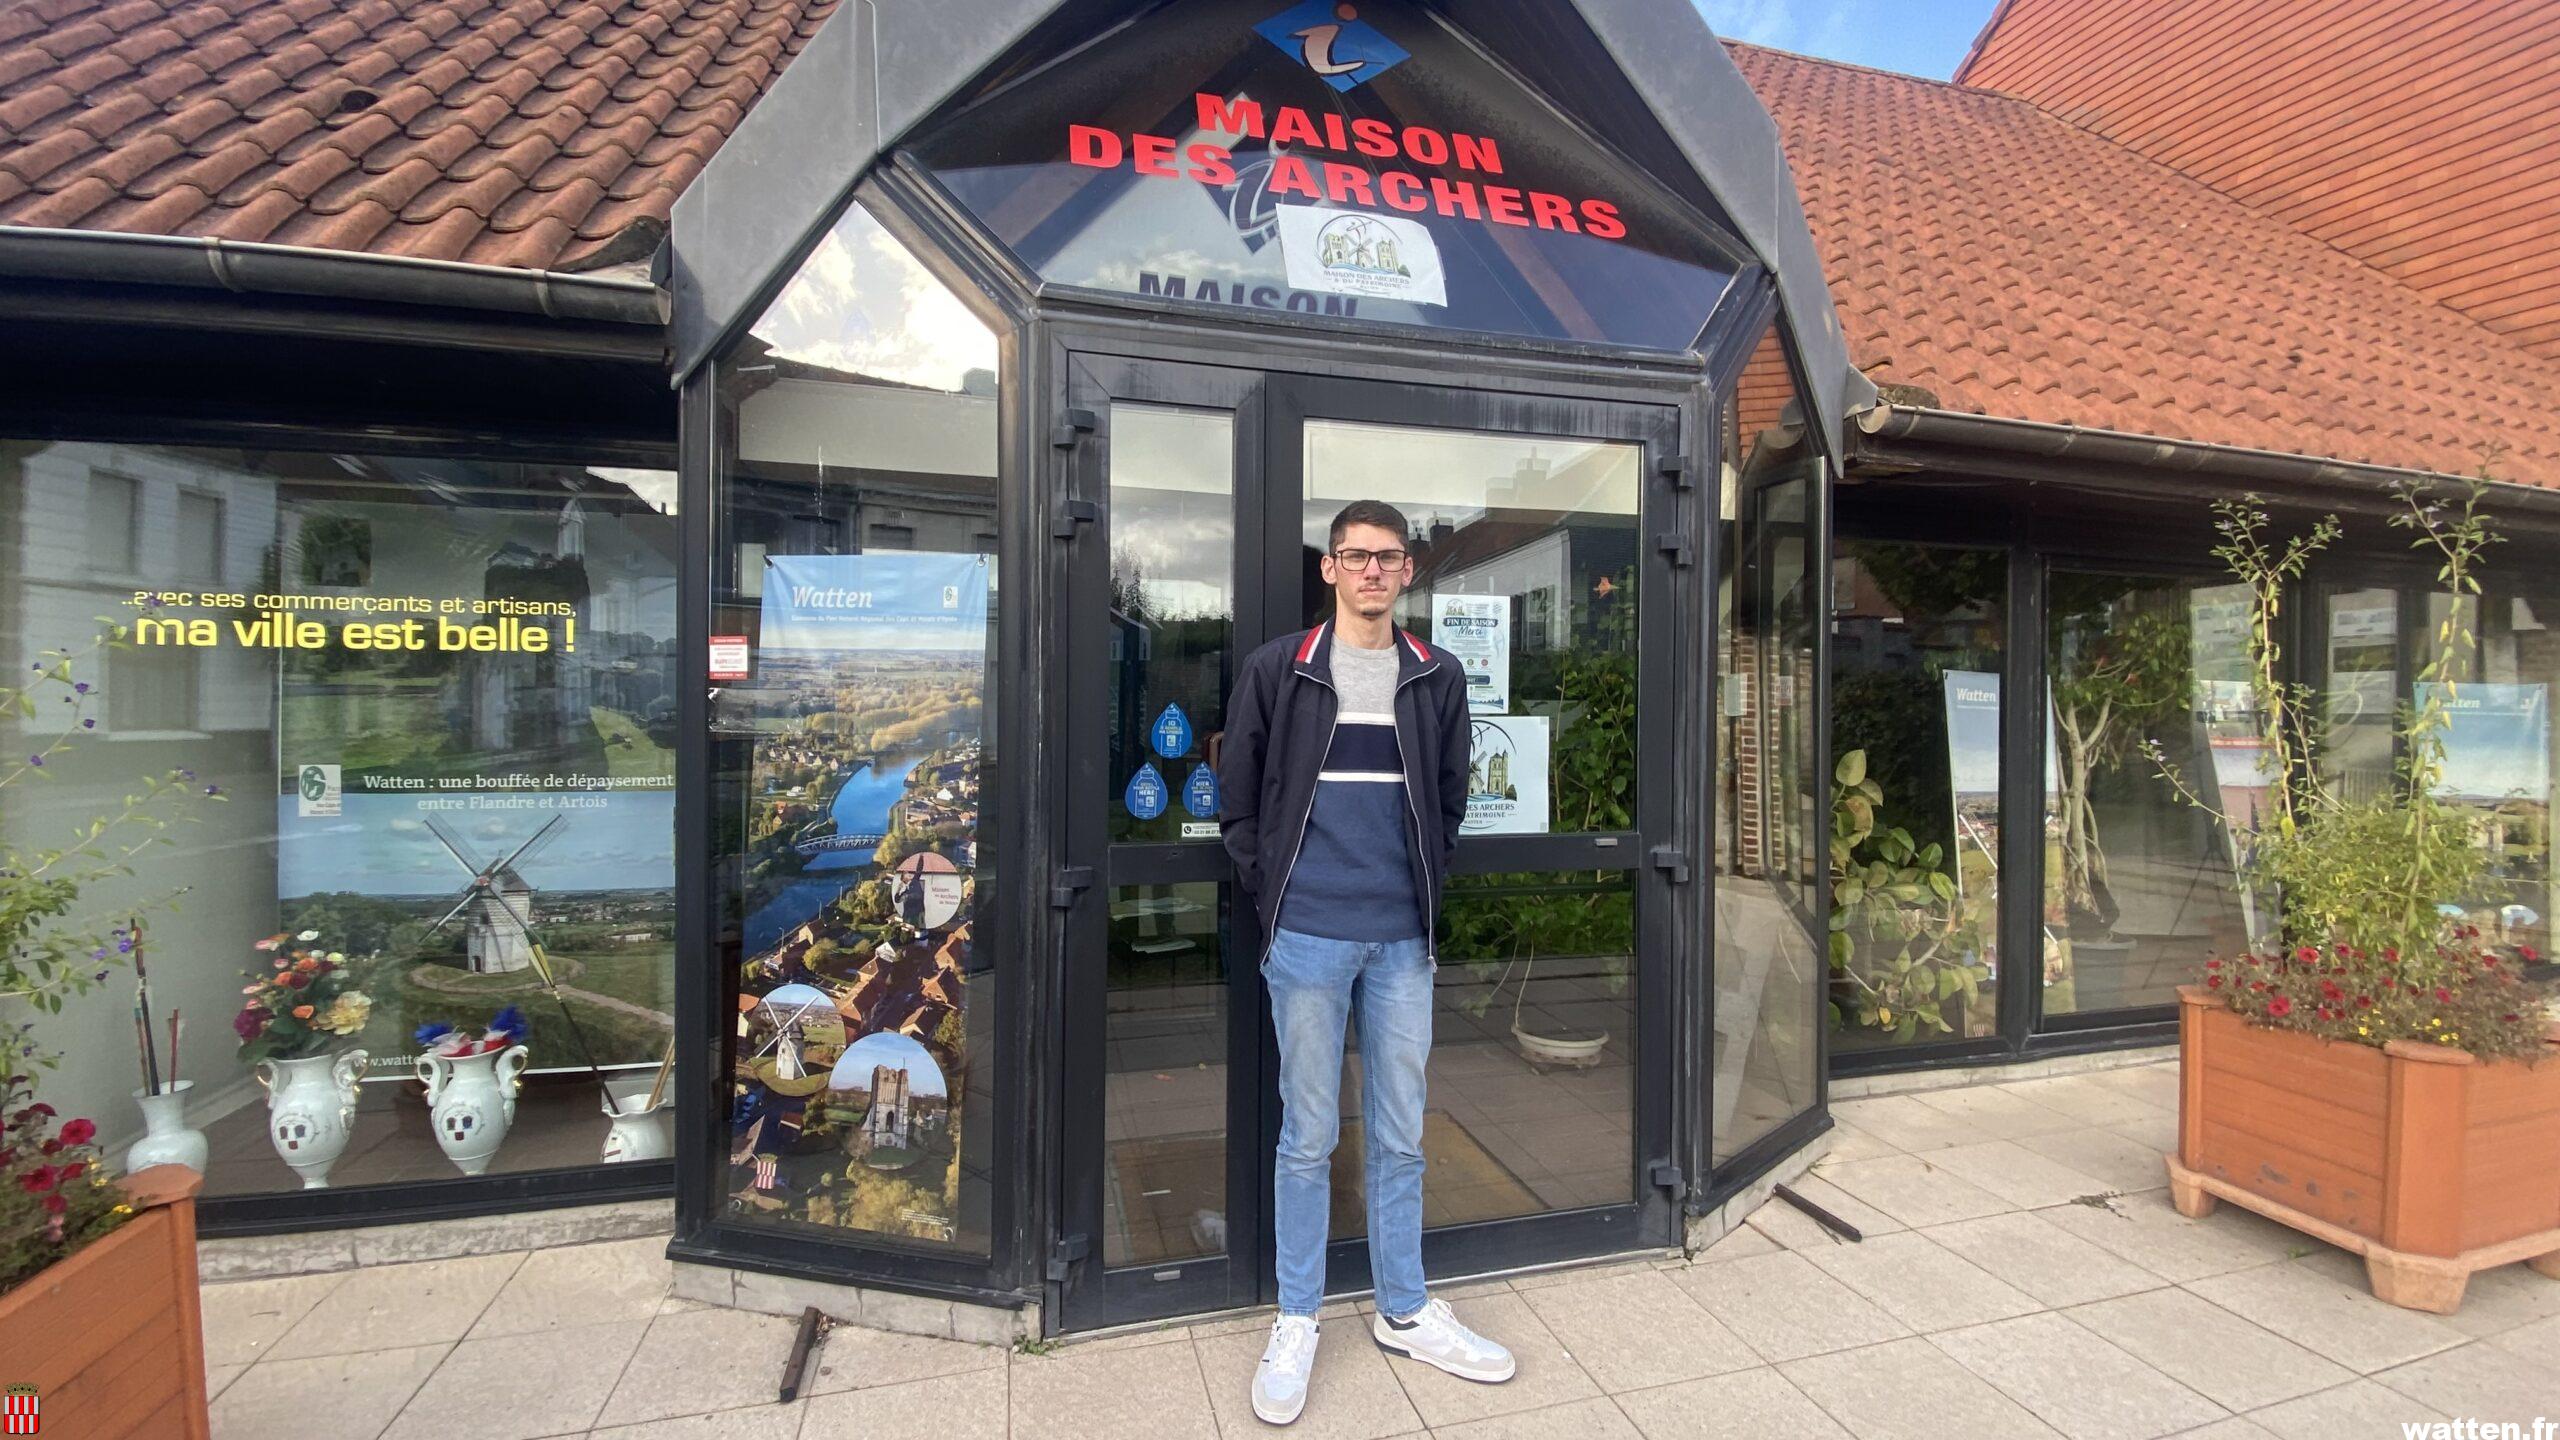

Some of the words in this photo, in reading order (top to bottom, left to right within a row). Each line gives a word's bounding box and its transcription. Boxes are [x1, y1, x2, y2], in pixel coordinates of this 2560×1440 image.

[1196, 92, 1503, 175] MAISON
[1069, 124, 1236, 185] DES
[1268, 154, 1627, 239] ARCHERS
[201, 592, 246, 608] ses
[253, 594, 432, 615] commerçants
[440, 597, 466, 613] et
[472, 596, 577, 617] artisans,
[792, 586, 873, 609] Watten
[136, 618, 218, 646] ma
[232, 611, 326, 649] ville
[342, 618, 425, 650] est
[438, 616, 548, 653] belle
[565, 618, 575, 653] !
[1447, 618, 1459, 626] FIN
[1471, 619, 1496, 627] SAISON
[1956, 687, 1997, 702] Watten
[363, 775, 425, 789] Watten
[429, 778, 434, 788] :
[439, 777, 472, 788] une
[475, 773, 540, 788] bouffée
[543, 773, 563, 787] de
[567, 773, 675, 790] dépaysement
[417, 799, 465, 810] entre
[469, 795, 535, 809] Flandre
[538, 796, 554, 808] et
[557, 795, 608, 808] Artois
[1480, 803, 1515, 811] ARCHERS
